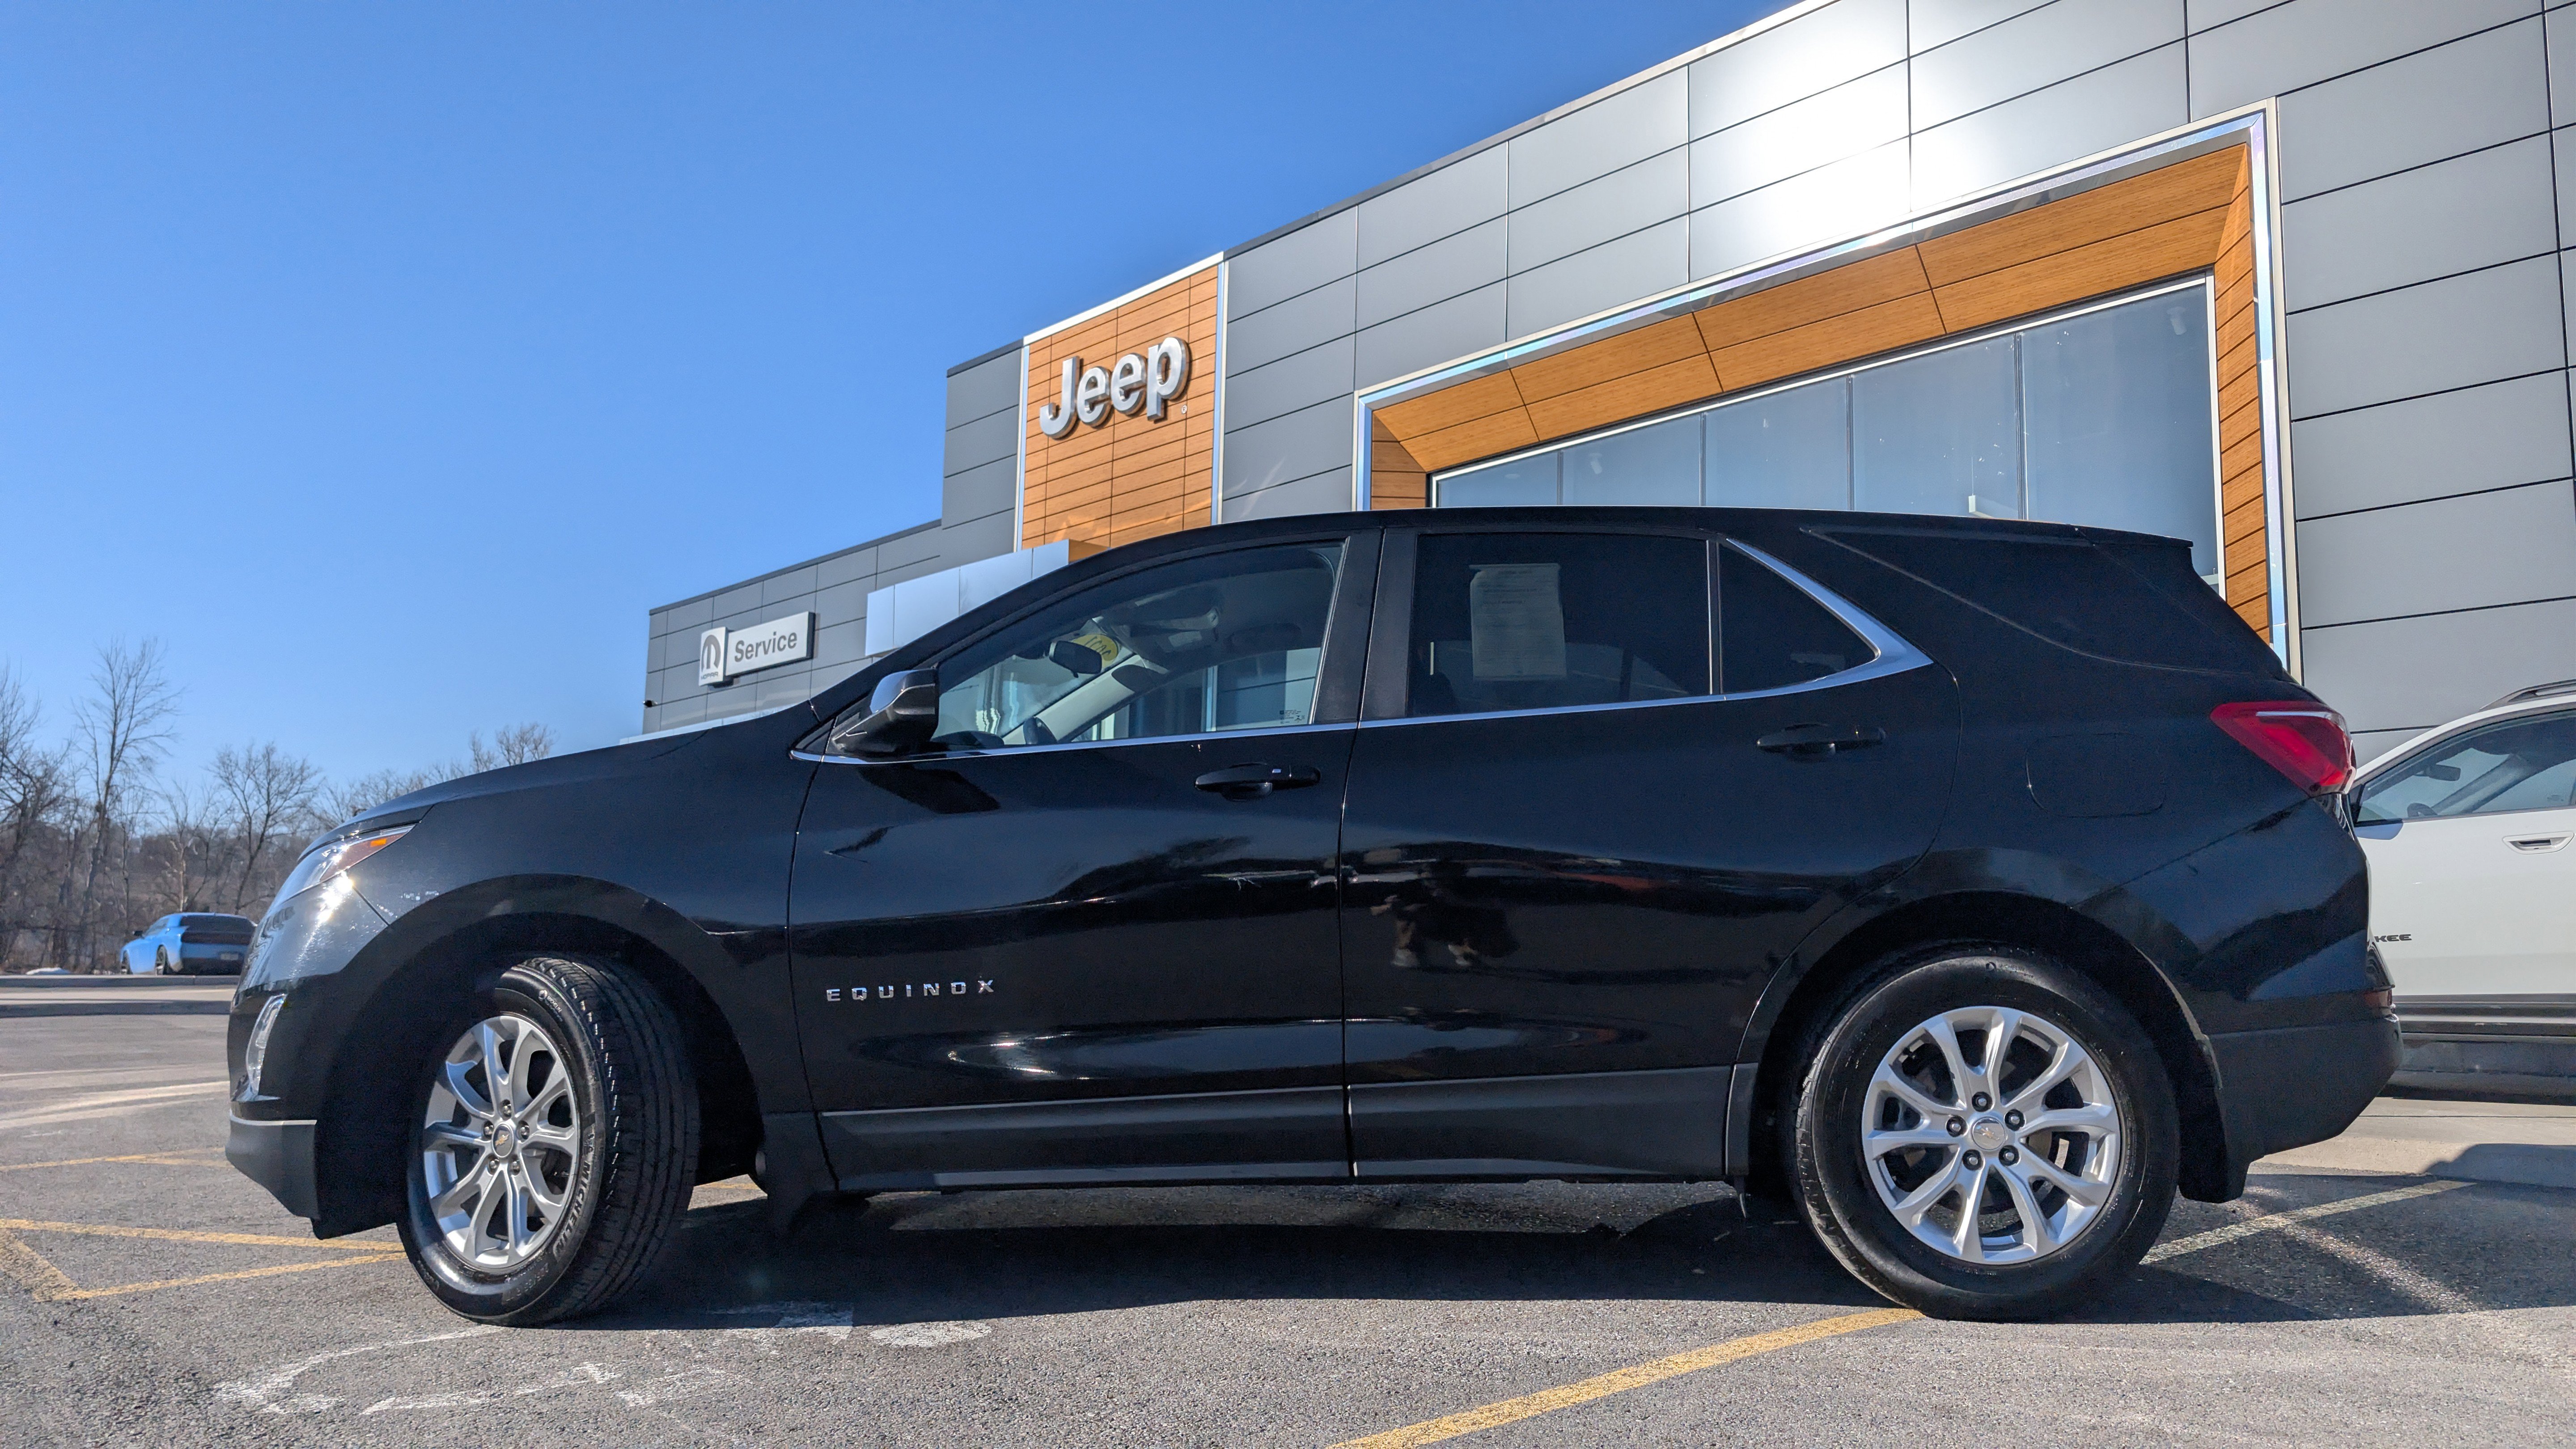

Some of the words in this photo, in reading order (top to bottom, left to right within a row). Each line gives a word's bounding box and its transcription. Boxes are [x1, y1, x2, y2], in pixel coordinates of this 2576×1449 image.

[1039, 337, 1191, 439] Jeep
[734, 631, 797, 662] Service
[547, 996, 562, 1013] MICHELIN
[826, 980, 994, 1001] EQUINOX
[556, 1161, 590, 1250] MICHELIN
